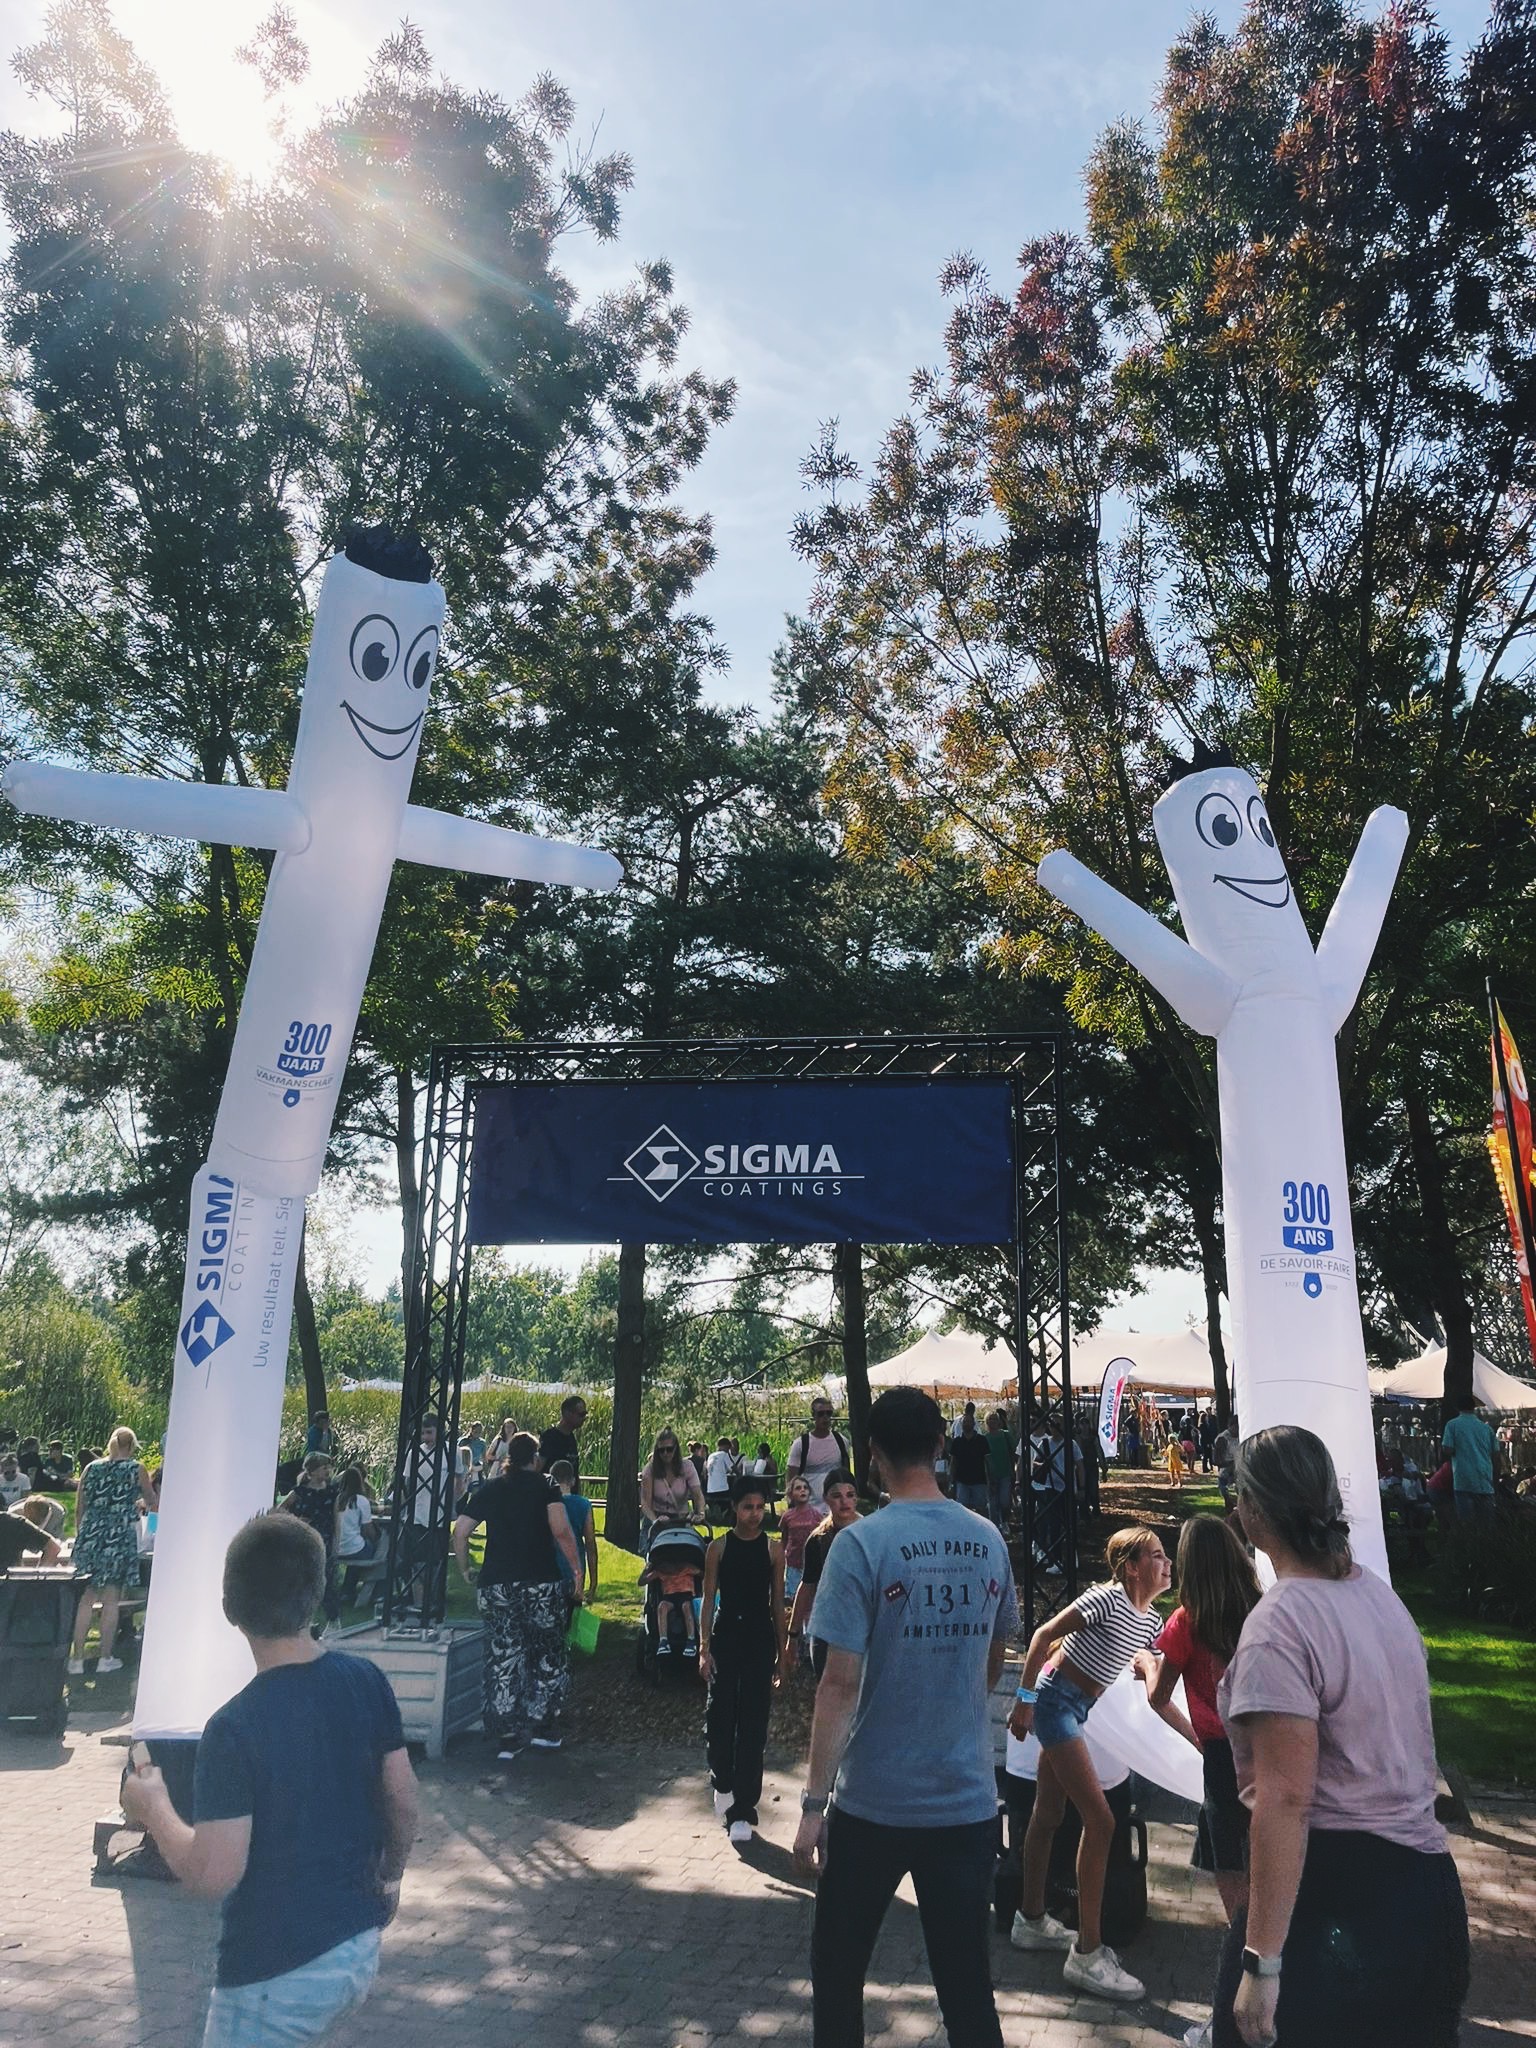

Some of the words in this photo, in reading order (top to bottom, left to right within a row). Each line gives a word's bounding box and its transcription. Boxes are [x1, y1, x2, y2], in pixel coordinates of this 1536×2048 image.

[284, 1021, 332, 1055] 300
[281, 1057, 320, 1071] JAAR
[704, 1144, 842, 1174] SIGMA
[703, 1181, 842, 1196] COATINGS
[1283, 1181, 1330, 1225] 300
[229, 1185, 256, 1291] COATIN
[1293, 1229, 1327, 1247] ANS
[1260, 1259, 1276, 1269] DE
[1279, 1258, 1351, 1275] SAVOIR-FAIRE
[253, 1341, 269, 1368] Uw
[261, 1262, 282, 1331] resultaat
[273, 1226, 287, 1257] telt.
[1105, 1388, 1116, 1420] SIGMA
[901, 1541, 937, 1560] DAILY
[944, 1541, 988, 1560] PAPER
[924, 1584, 970, 1614] 131
[904, 1623, 988, 1638] AMSTERDAM
